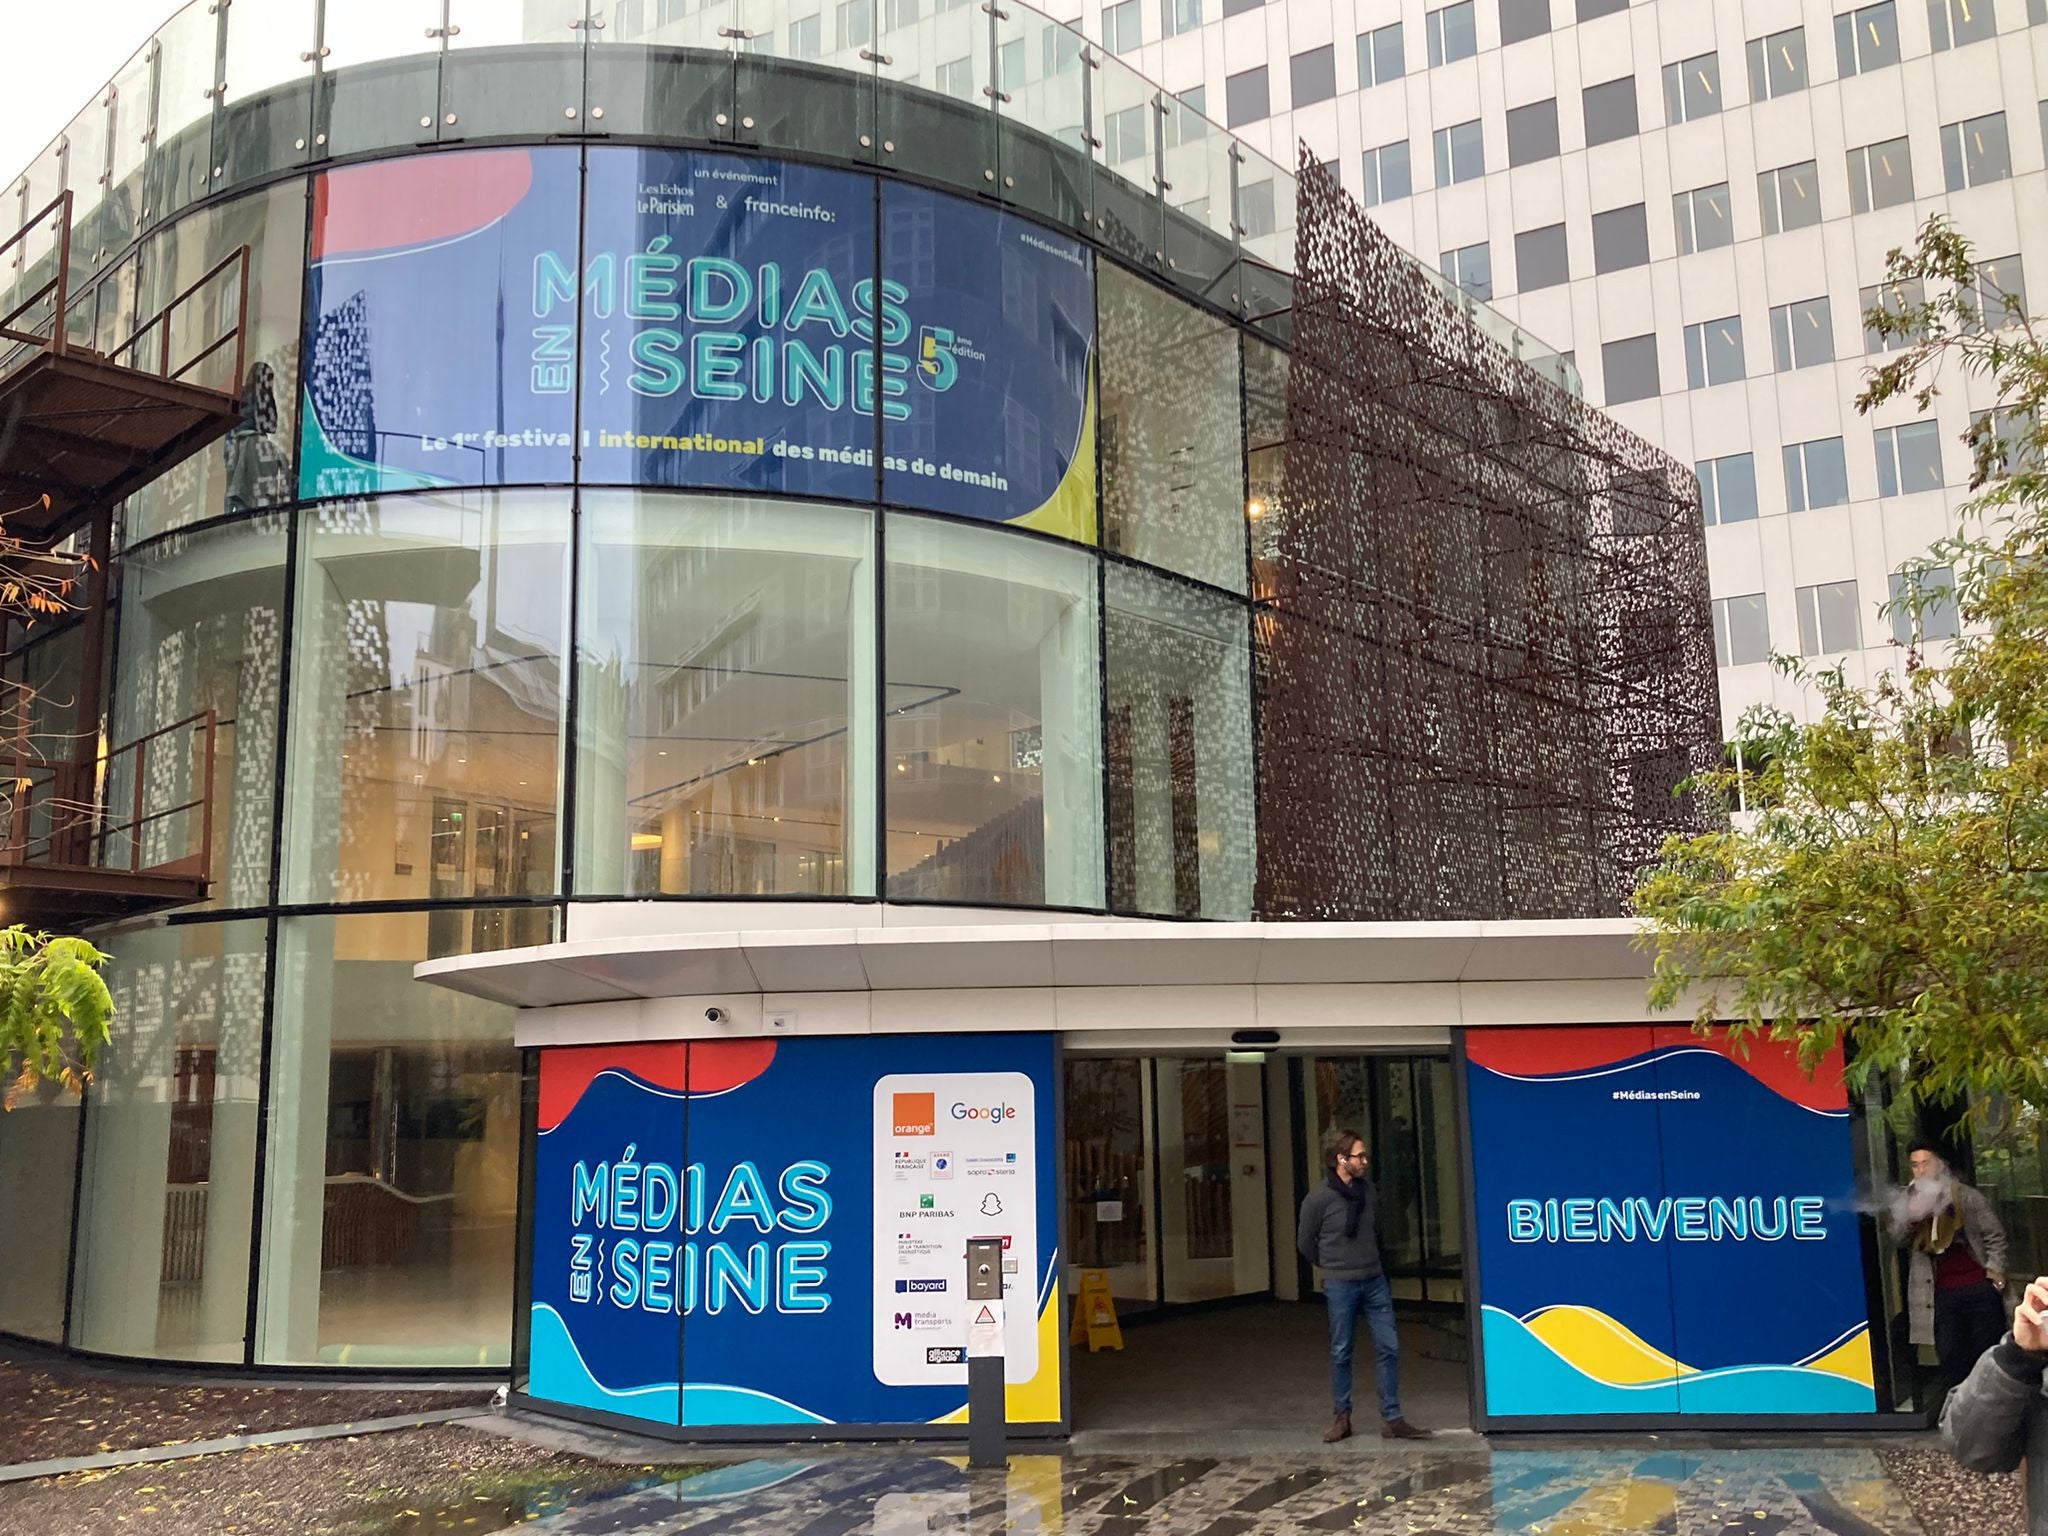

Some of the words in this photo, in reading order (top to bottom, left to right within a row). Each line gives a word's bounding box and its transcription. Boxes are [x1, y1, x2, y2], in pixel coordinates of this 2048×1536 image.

[694, 169, 710, 179] un
[712, 169, 778, 186] événement
[649, 196, 694, 216] Parisien
[716, 195, 728, 209] &
[744, 196, 836, 222] franceinfo:
[533, 235, 912, 347] MÉDIAS
[531, 323, 574, 394] EN
[916, 325, 958, 392] 5
[951, 344, 986, 361] édition
[627, 327, 913, 421] SEINE
[421, 434, 447, 451] Le
[599, 430, 763, 455] international
[772, 439, 814, 460] des
[819, 445, 907, 472] médias
[911, 458, 936, 476] de
[940, 463, 1008, 491] demain
[1612, 1090, 1700, 1100] #MédiasenSeine
[951, 1102, 1015, 1124] Google
[895, 1124, 931, 1135] orange
[571, 1142, 833, 1234] MÉDIAS
[919, 1210, 955, 1218] PARIBAS
[1507, 1196, 1827, 1243] BIENVENUE
[569, 1234, 593, 1304] EN
[610, 1237, 833, 1316] SEINE
[910, 1281, 945, 1291] bayard
